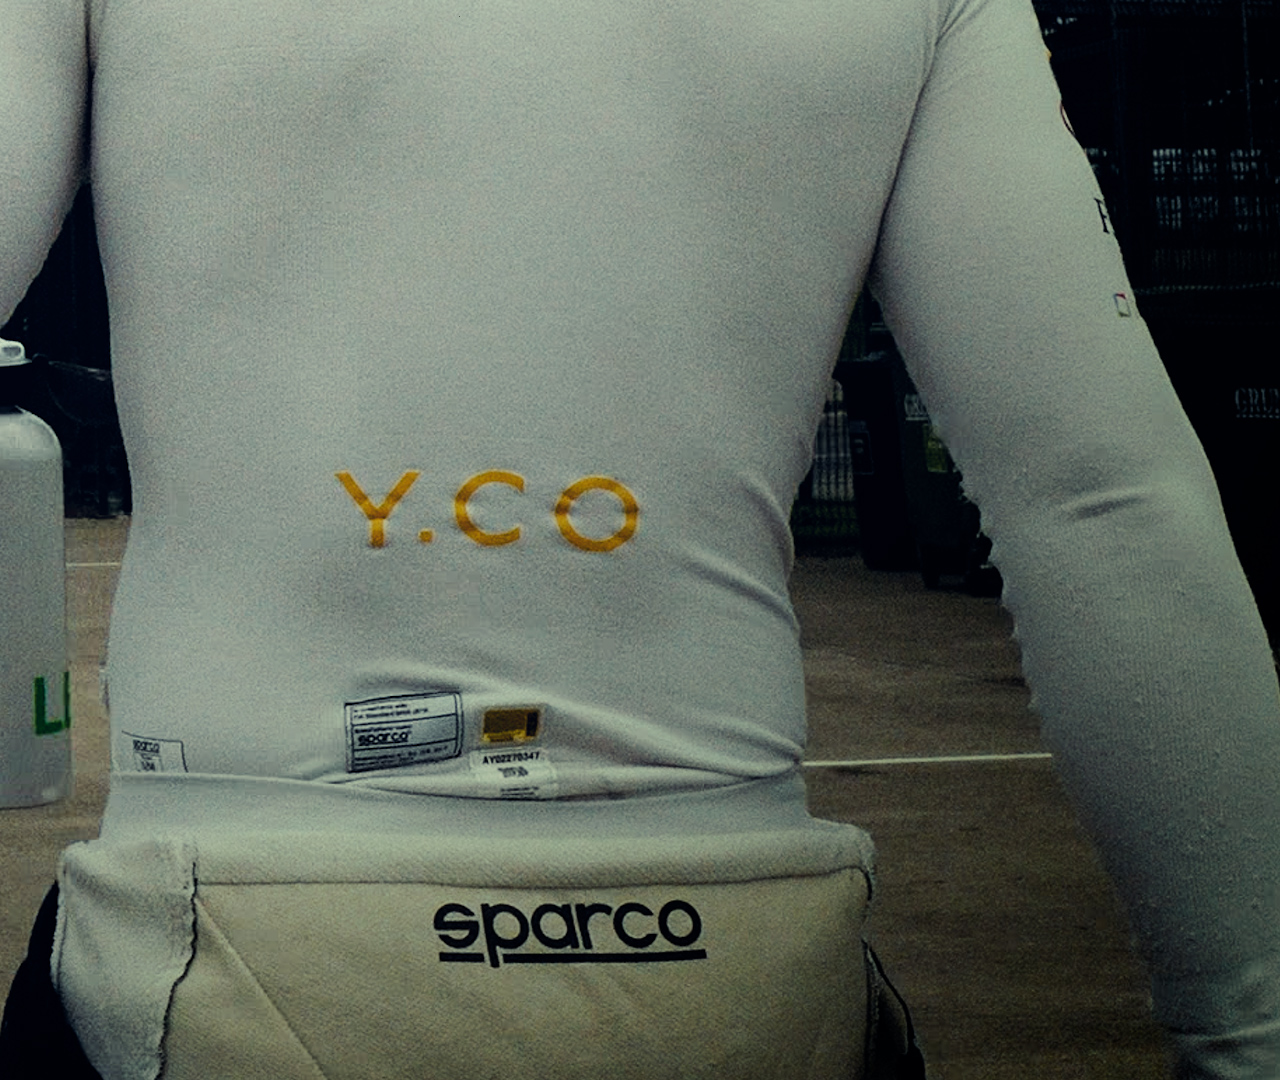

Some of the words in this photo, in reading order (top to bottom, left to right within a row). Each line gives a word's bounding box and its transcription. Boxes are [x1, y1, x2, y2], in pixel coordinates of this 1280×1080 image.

[334, 469, 640, 552] Y.CO
[33, 672, 71, 736] L
[433, 899, 707, 968] sparco
